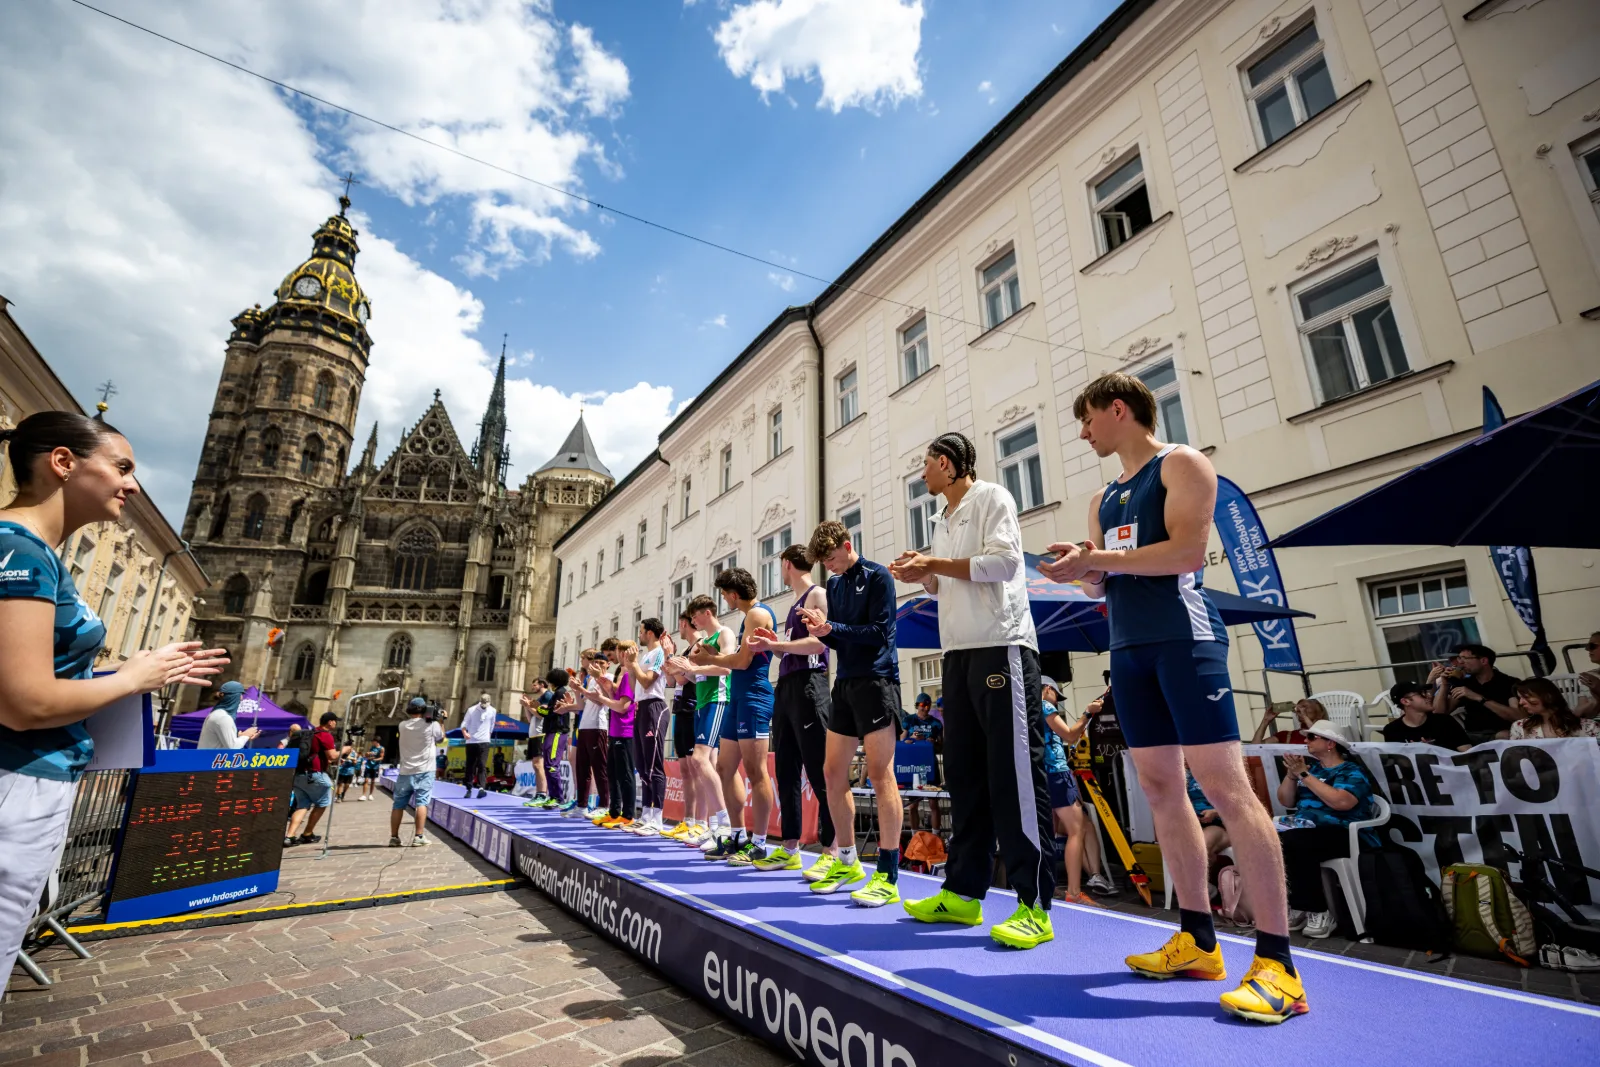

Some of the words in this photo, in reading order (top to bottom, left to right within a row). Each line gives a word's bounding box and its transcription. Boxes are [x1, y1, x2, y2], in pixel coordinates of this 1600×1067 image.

[250, 752, 290, 768] ŠPORT
[896, 764, 932, 774] TimeTrocs
[1451, 746, 1560, 804] TO
[130, 803, 203, 825] JUMP
[218, 796, 278, 817] FEST
[188, 884, 258, 907] www.hrdosport.sk
[520, 853, 662, 965] european-athletics.com
